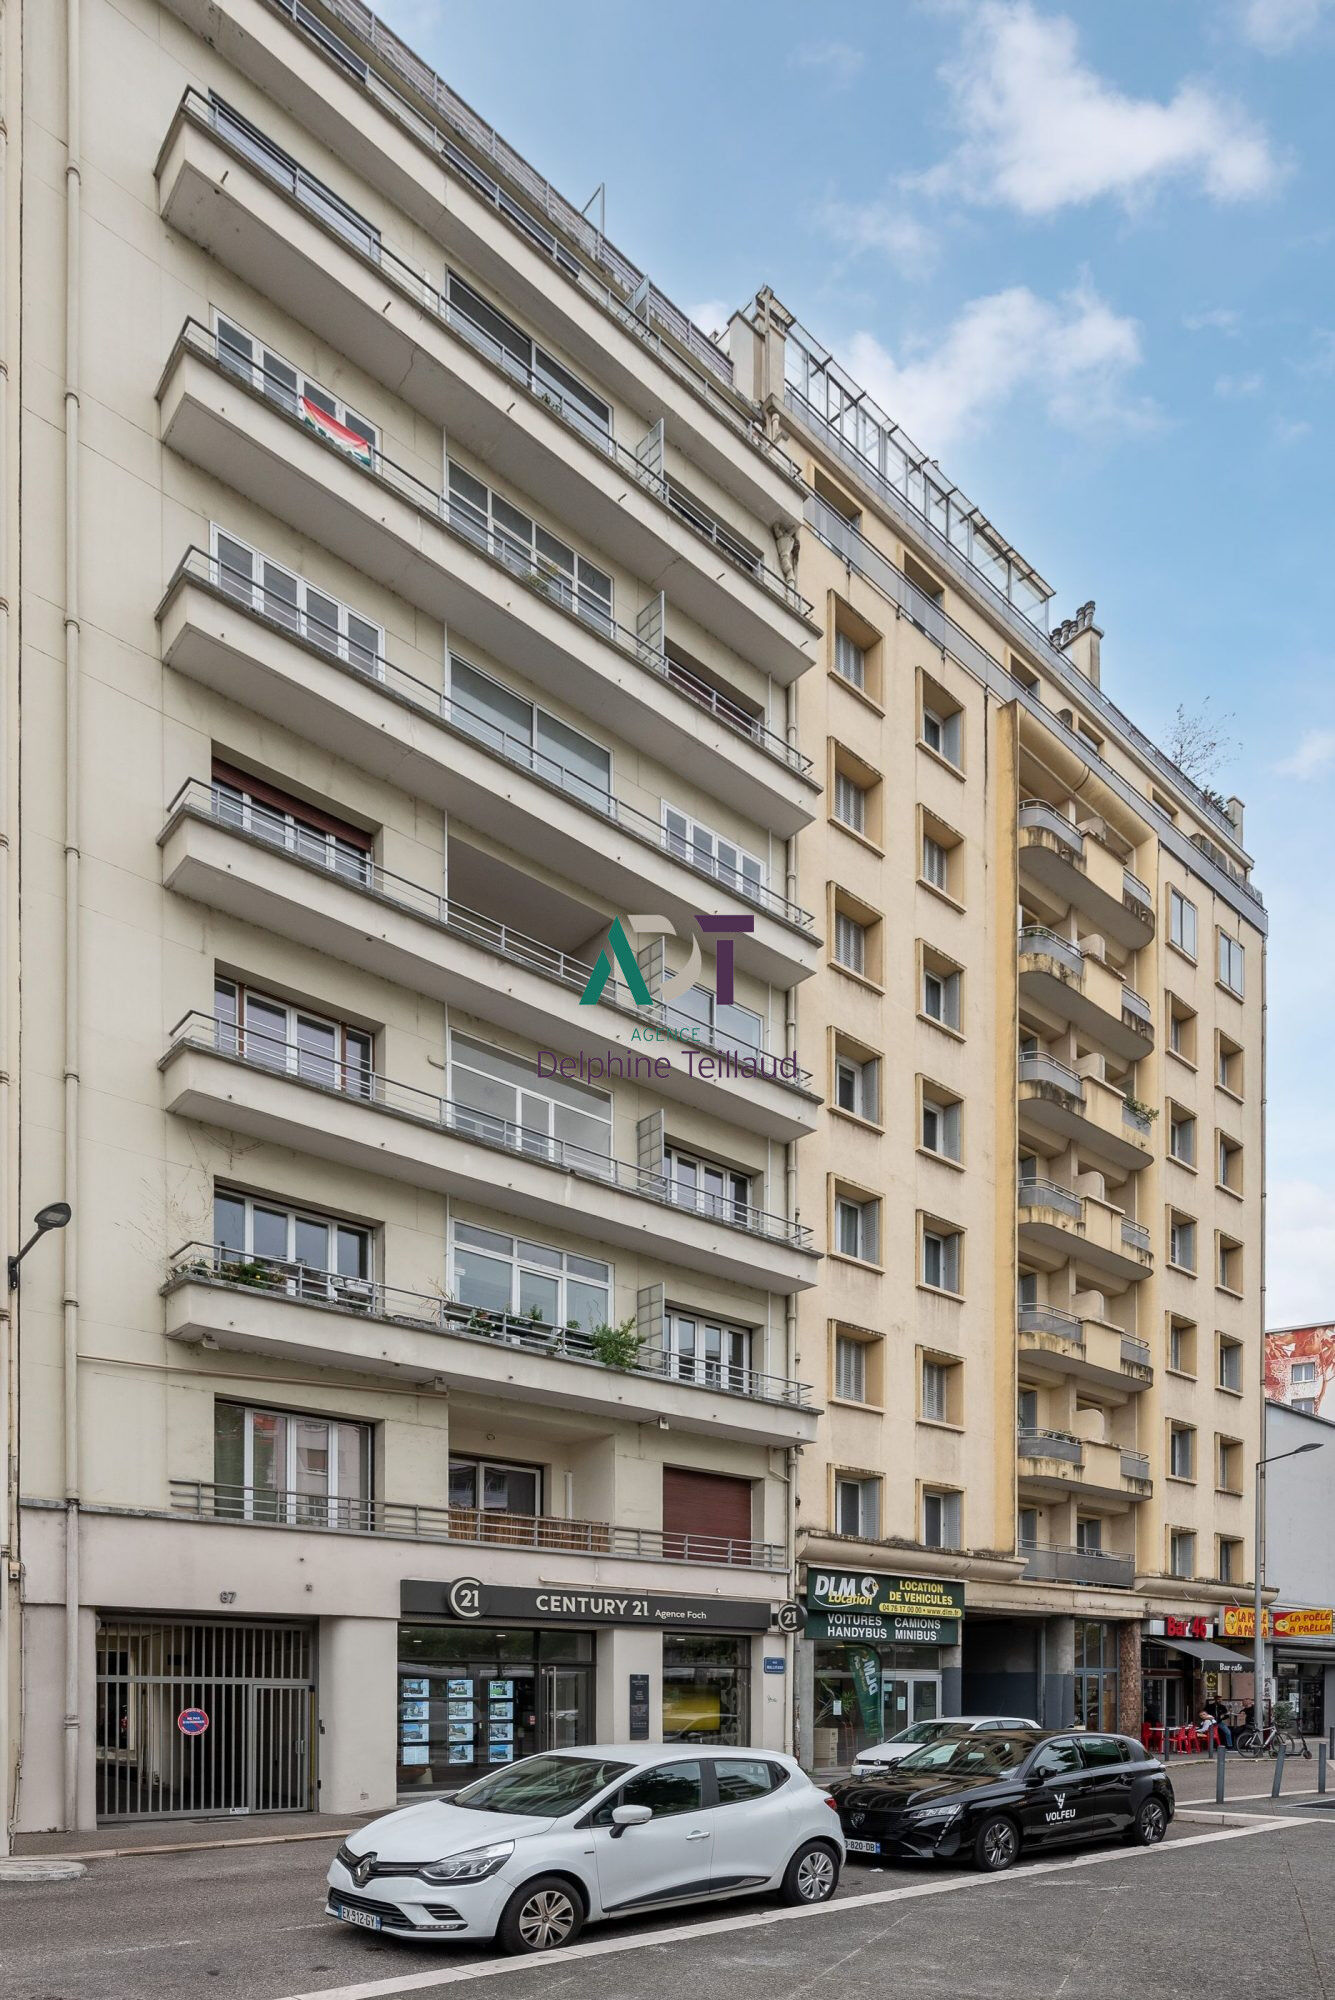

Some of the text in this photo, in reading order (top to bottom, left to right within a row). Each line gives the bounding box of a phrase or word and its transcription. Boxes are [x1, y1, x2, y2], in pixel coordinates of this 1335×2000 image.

[814, 1575, 855, 1597] DLM
[900, 1580, 944, 1593] LOCATION
[828, 1592, 873, 1606] Location
[889, 1591, 953, 1606] DE VEHICULES
[535, 1595, 707, 1620] CENTURY 21 Agence Foch
[827, 1613, 941, 1630] VOITURES CAMIONS
[1238, 1611, 1246, 1622] LA
[827, 1626, 937, 1641] HANDYBUS MINIBUS
[1167, 1616, 1188, 1637] Bar
[1219, 1663, 1230, 1671] Bar
[1045, 1808, 1076, 1822] VOLFEU
